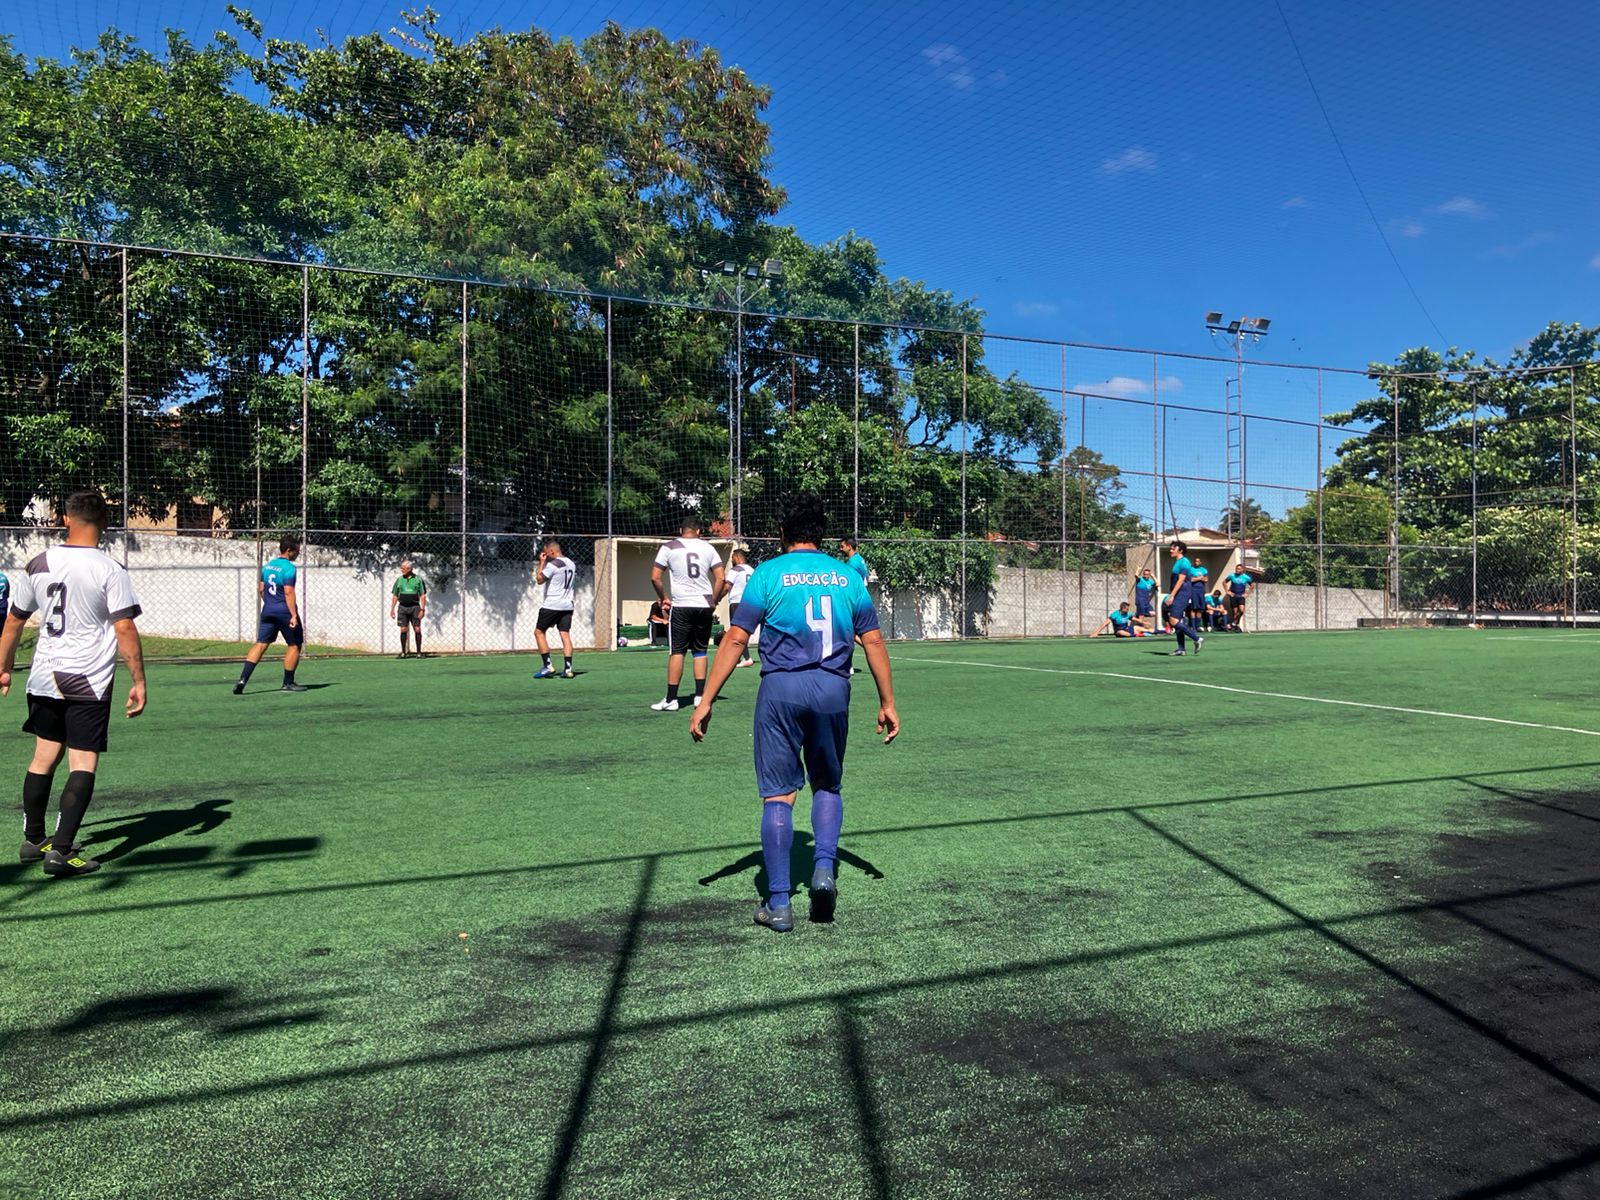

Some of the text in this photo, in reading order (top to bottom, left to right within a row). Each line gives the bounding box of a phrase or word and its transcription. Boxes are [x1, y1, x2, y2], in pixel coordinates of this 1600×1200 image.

[686, 552, 700, 578] 6
[268, 574, 277, 595] 5
[782, 571, 848, 587] EDUCAÇÃO
[46, 582, 67, 638] 3
[805, 594, 832, 659] 4
